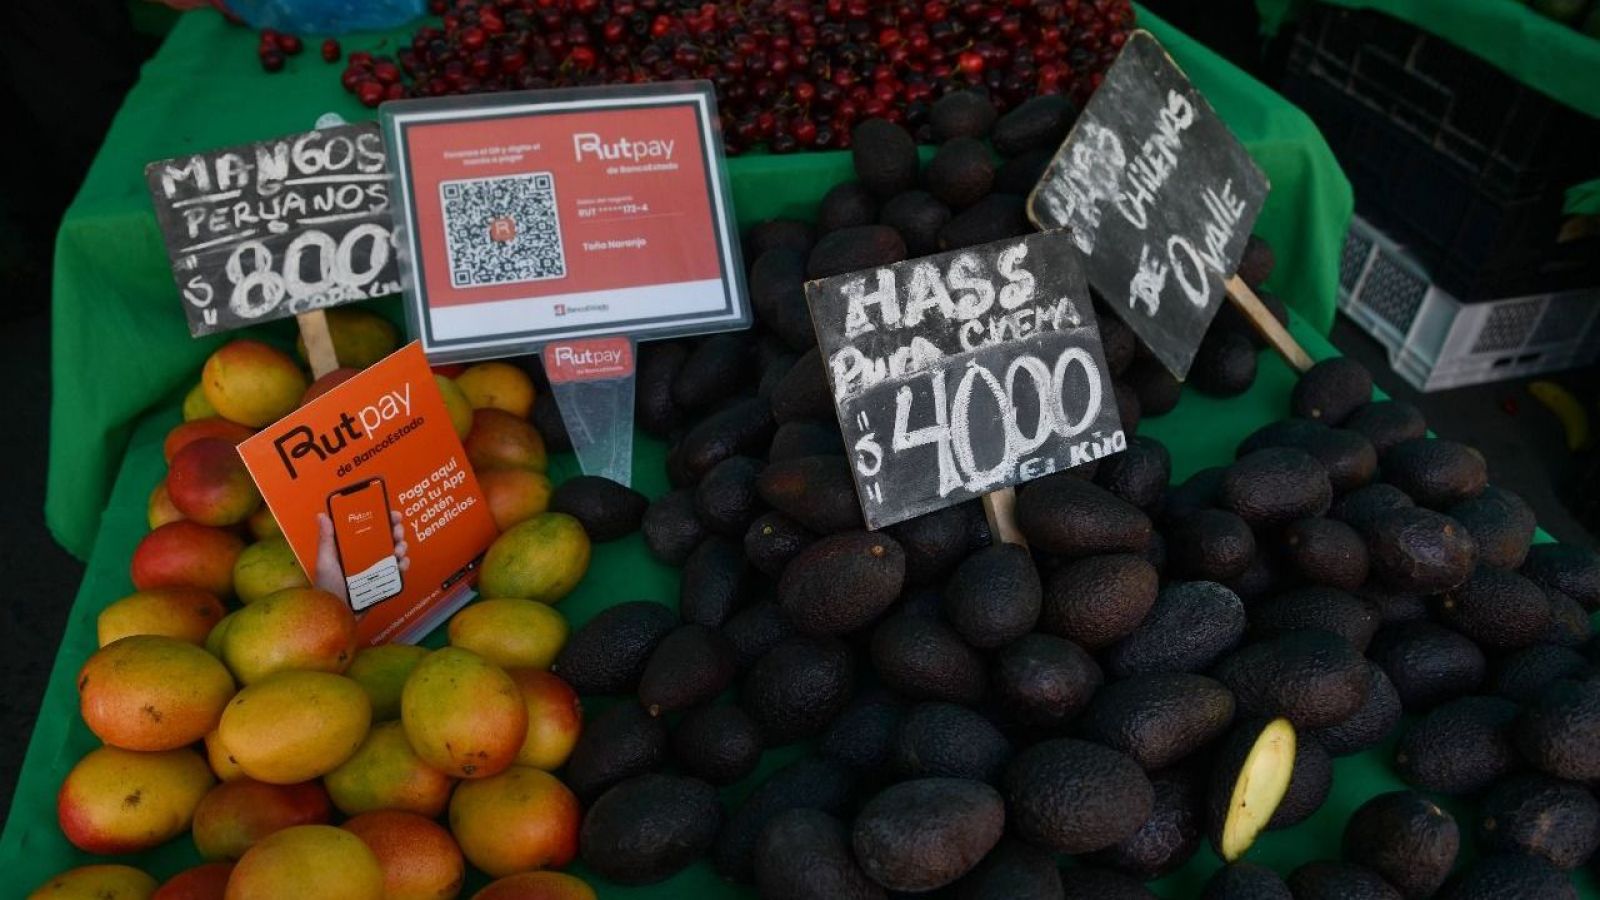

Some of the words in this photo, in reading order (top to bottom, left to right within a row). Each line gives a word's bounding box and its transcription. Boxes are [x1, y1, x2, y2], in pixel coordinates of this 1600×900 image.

[161, 131, 386, 198] MANGOS
[572, 132, 675, 163] Rutpay
[183, 183, 388, 238] PERUANOS
[840, 242, 1036, 338] HASS
[554, 346, 622, 367] Rutpay
[273, 382, 411, 480] Rutpay
[336, 461, 352, 478] de
[352, 415, 425, 471] BancoEstado
[398, 478, 431, 505] Paga
[431, 456, 457, 483] aquí
[405, 497, 428, 517] con
[428, 486, 442, 500] tu
[443, 470, 466, 491] App
[410, 519, 419, 533] y
[420, 495, 455, 523] obtén
[416, 496, 477, 542] beneficios.
